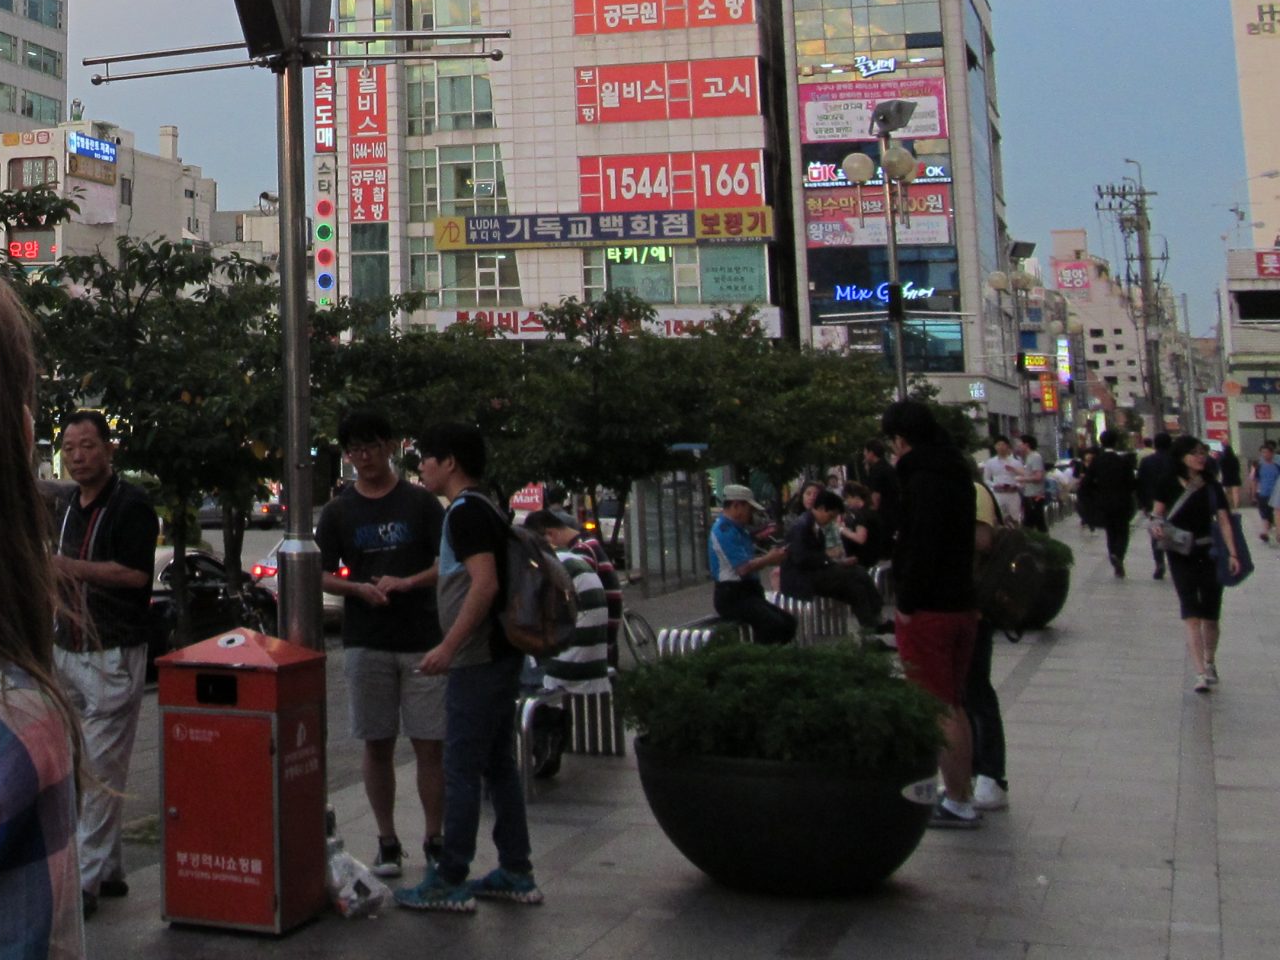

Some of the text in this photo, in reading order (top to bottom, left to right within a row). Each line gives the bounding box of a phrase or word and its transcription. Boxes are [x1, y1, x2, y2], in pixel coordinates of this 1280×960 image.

[604, 2, 658, 29] 공무원
[600, 80, 665, 108] 윌비스
[702, 75, 751, 98] 고시
[352, 142, 387, 160] 1544-1661
[351, 169, 386, 186] 공무원
[606, 162, 763, 200] 1544 1661
[470, 219, 500, 231] LUDIA
[9, 241, 39, 258] 요양
[835, 285, 873, 301] Mix
[514, 495, 539, 504] Mart
